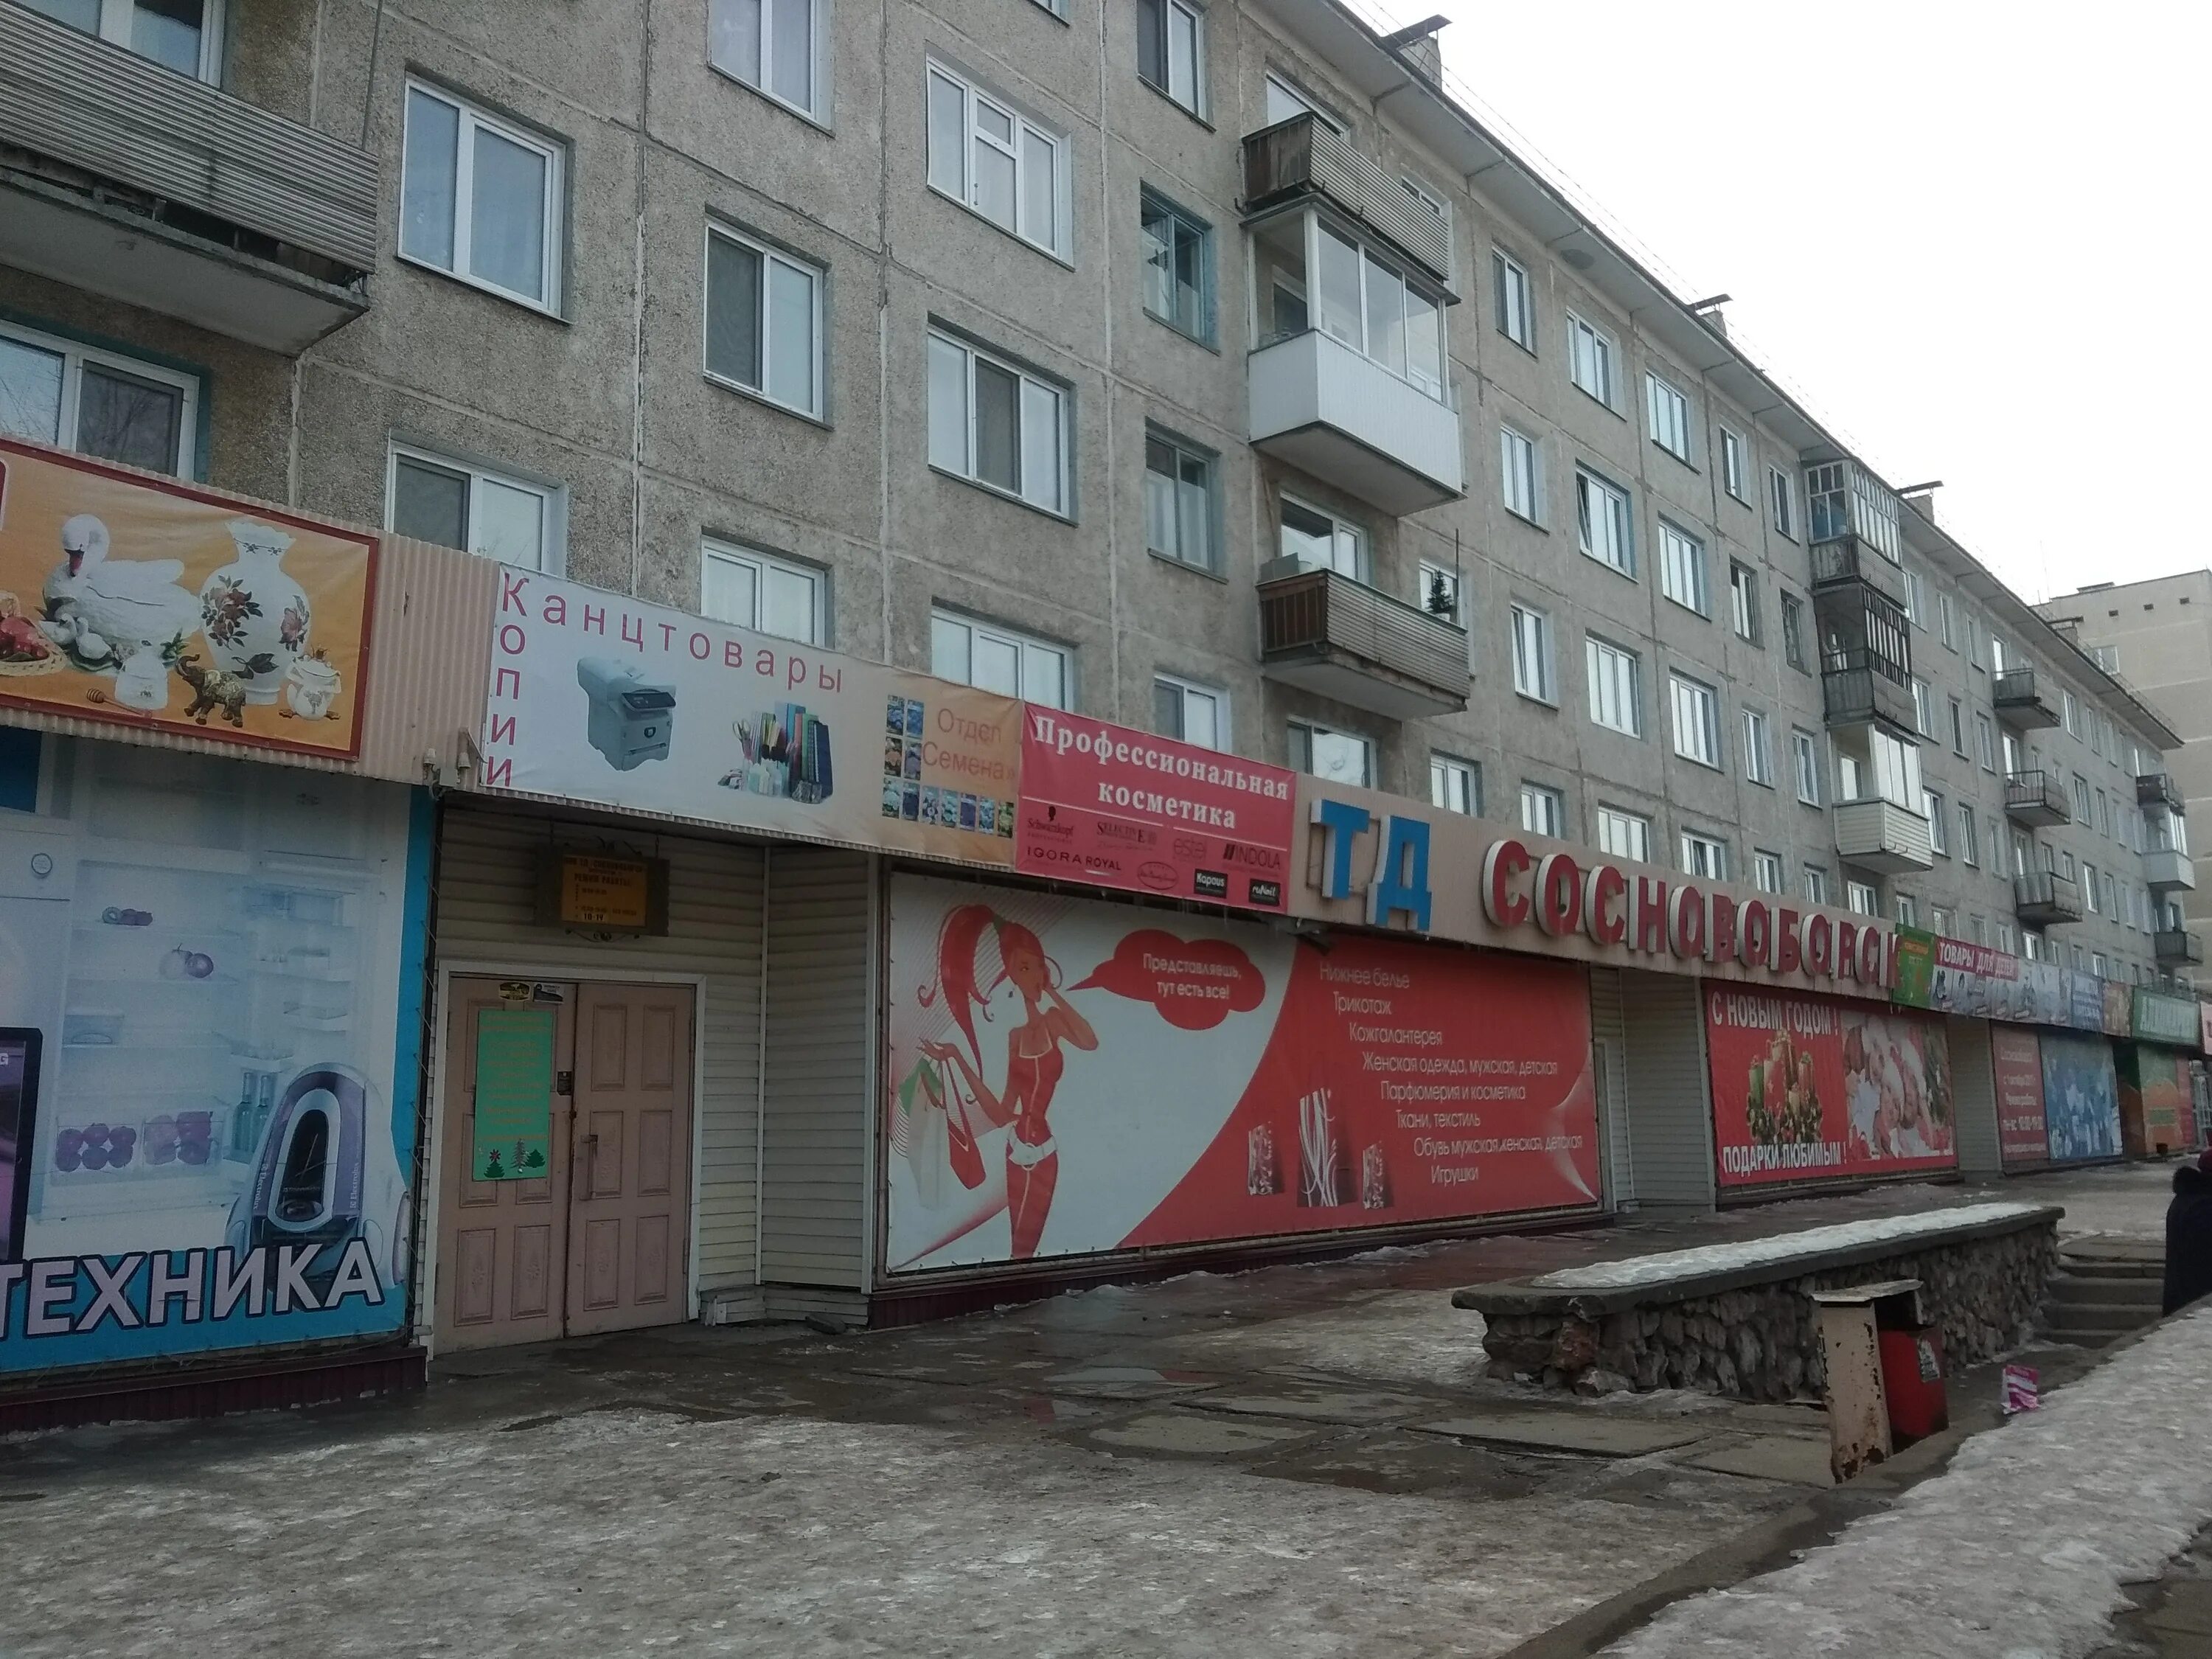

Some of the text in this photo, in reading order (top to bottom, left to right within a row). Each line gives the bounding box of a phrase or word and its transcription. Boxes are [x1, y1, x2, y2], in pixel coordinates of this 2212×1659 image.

[502, 573, 842, 693] Канцтовары
[486, 573, 529, 787] Копии
[937, 708, 1002, 744] Отдел
[1034, 714, 1290, 800] Профессиональная
[1098, 782, 1236, 829] косметика
[1027, 846, 1082, 864] IGORA
[1085, 856, 1121, 871] ROYAL
[1235, 846, 1281, 870] INDOLA
[1311, 799, 1904, 989] ТД СОСНОВОБОРСК
[1143, 953, 1241, 980] Представляешь,
[1939, 942, 1975, 968] ТОВАРЫ
[1977, 952, 1994, 974] ДЛЯ
[1320, 962, 1410, 990] Нижнее белье
[1157, 981, 1229, 1000] тут есть все!
[1333, 991, 1392, 1015] Трикотаж
[1711, 992, 1723, 1026] С
[1727, 993, 1783, 1030] НОВЫМ
[1786, 1001, 1832, 1040] ГОДОМ
[1349, 1022, 1442, 1048] Кожгалантерея
[1363, 1051, 1417, 1074] Женская
[1519, 1060, 1558, 1077] детская
[1380, 1080, 1526, 1105] Парфюмерия и косметика
[1397, 1110, 1481, 1130] Ткани, текстиль
[1413, 1137, 1450, 1158] Обувь
[1545, 1135, 1583, 1152] детская
[1722, 1144, 1781, 1178] ПОДАРКИ
[1781, 1141, 1841, 1169] ЛЮБИМЫМ
[1431, 1165, 1479, 1186] Игрушки
[252, 1172, 267, 1211] Electrolux
